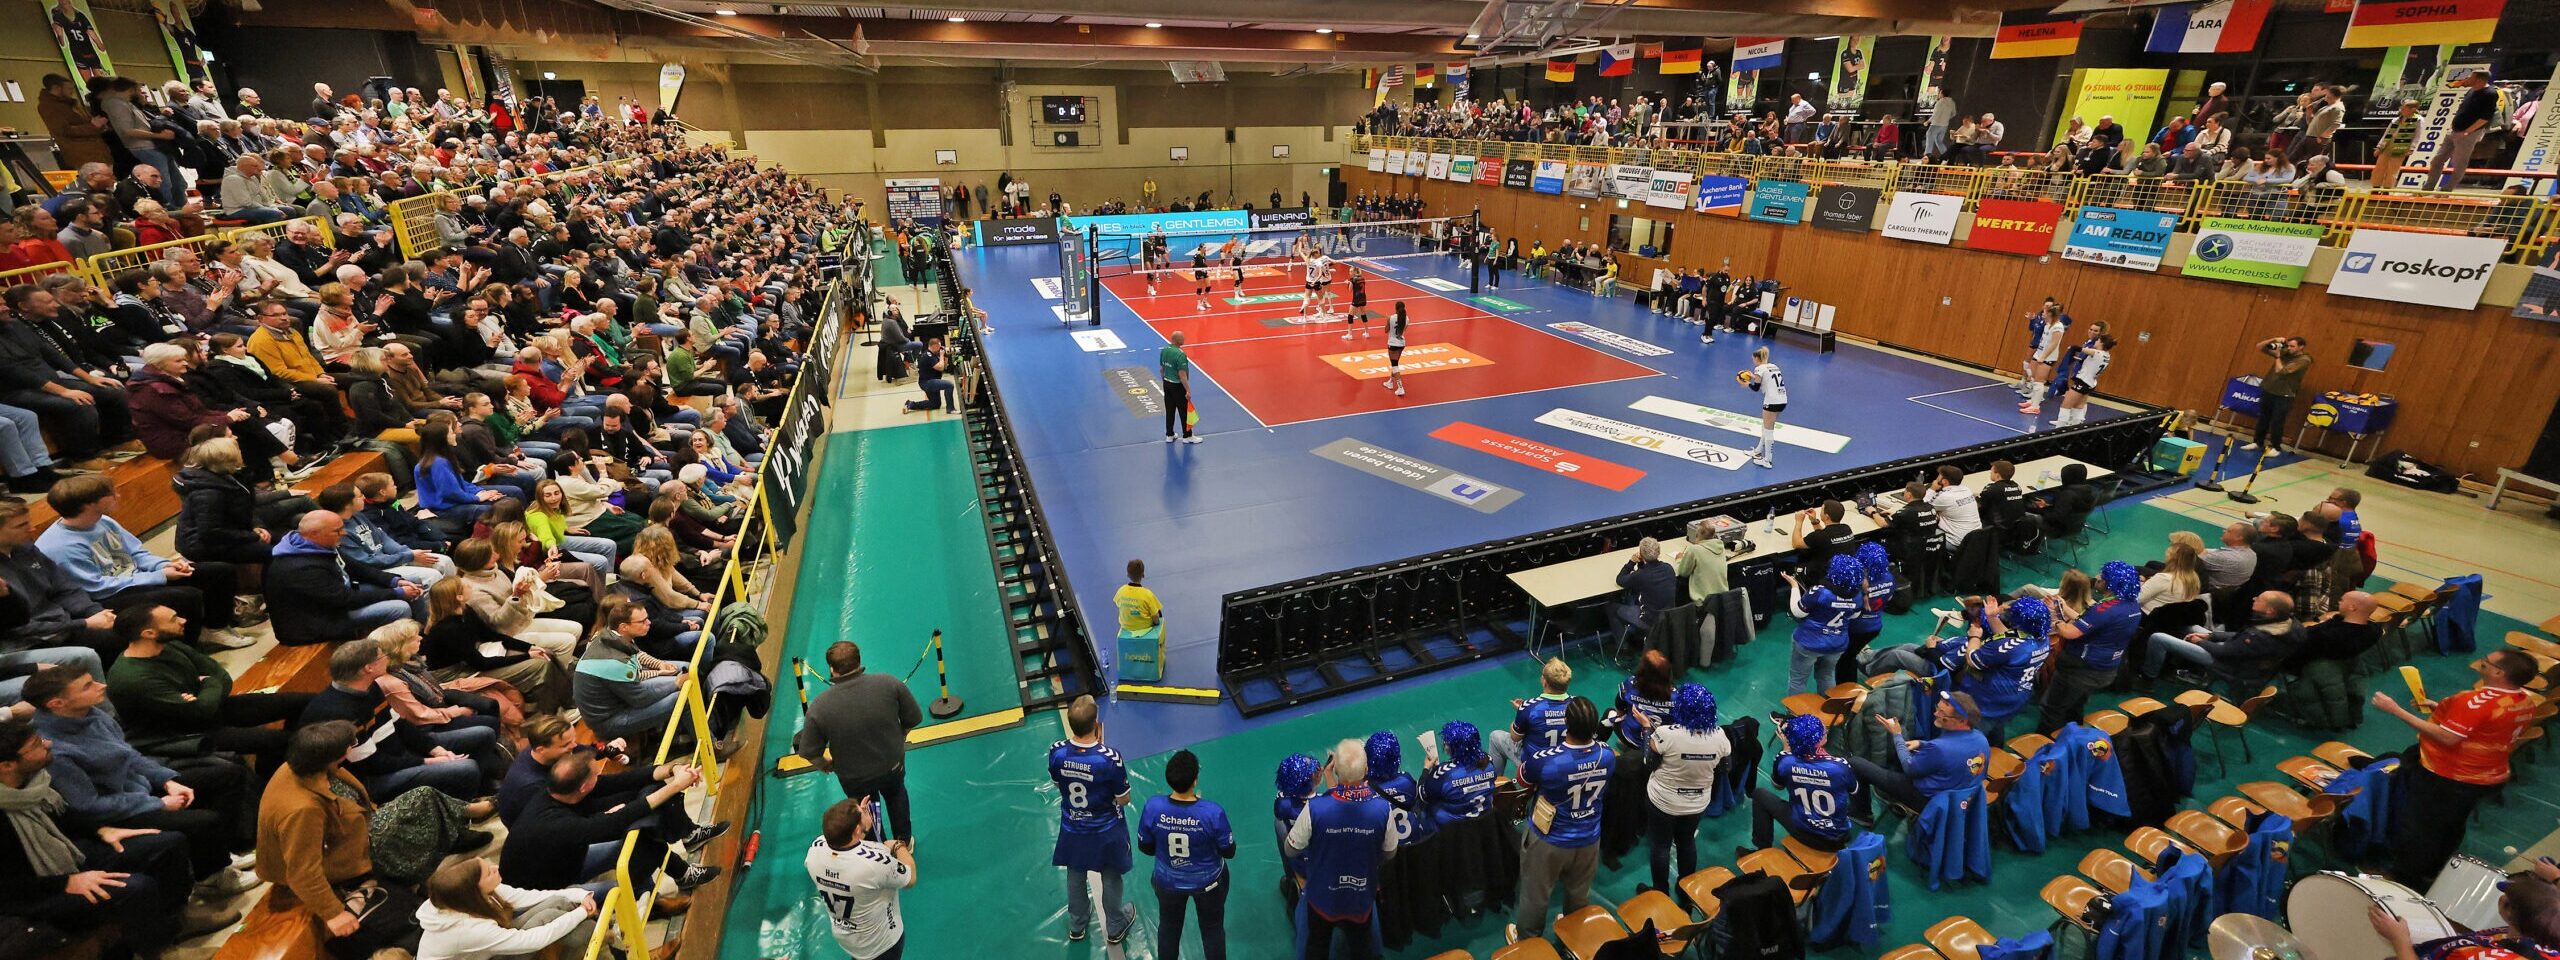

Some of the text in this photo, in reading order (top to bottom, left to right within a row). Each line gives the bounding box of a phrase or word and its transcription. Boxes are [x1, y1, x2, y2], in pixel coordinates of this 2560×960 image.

[2395, 5, 2457, 18] SOPHIA
[2189, 19, 2222, 30] LARA
[70, 29, 85, 42] 15
[2018, 28, 2056, 37] HELENA
[1747, 46, 1768, 56] NICOLE
[2417, 92, 2458, 152] Beissel
[1651, 179, 1690, 194] WOF
[1701, 184, 1743, 194] Aachener Bank
[1760, 193, 1805, 203] GENTLEMEN
[1261, 212, 1308, 222] WIENAND
[1823, 210, 1845, 219] thomas
[1846, 212, 1862, 221] faber
[1165, 217, 1244, 230] GENTLEMEN
[1977, 217, 2053, 234] WERTZ.de
[2247, 224, 2285, 234] Michael
[2286, 227, 2313, 236] Neuß
[1887, 224, 1948, 237] CAROLUS THERMEN
[2083, 224, 2111, 237] AM
[2111, 228, 2168, 243] READY
[1266, 233, 1366, 259] STWAG
[2189, 263, 2288, 281] www.docneuss.de
[2380, 258, 2491, 283] roskopf
[1136, 394, 1162, 413] POWER
[1481, 438, 1553, 463] Sparkasse
[1509, 438, 1563, 457] Aachen
[1342, 449, 1425, 481] ideen bauen
[1359, 446, 1439, 474] nesseler.de
[1826, 611, 1845, 628] 4
[1063, 760, 1091, 773] STRUBBE
[1578, 761, 1597, 771] HART
[1791, 765, 1828, 779] KNOLLEMA
[1451, 775, 1473, 788] SEGURA
[1068, 782, 1089, 809] 8
[1567, 780, 1607, 811] 17
[1794, 787, 1836, 818] 10
[1160, 813, 1201, 826] Schaefer
[1354, 827, 1375, 836] Stuttgart
[1168, 832, 1190, 858] 8
[825, 868, 840, 880] Hart
